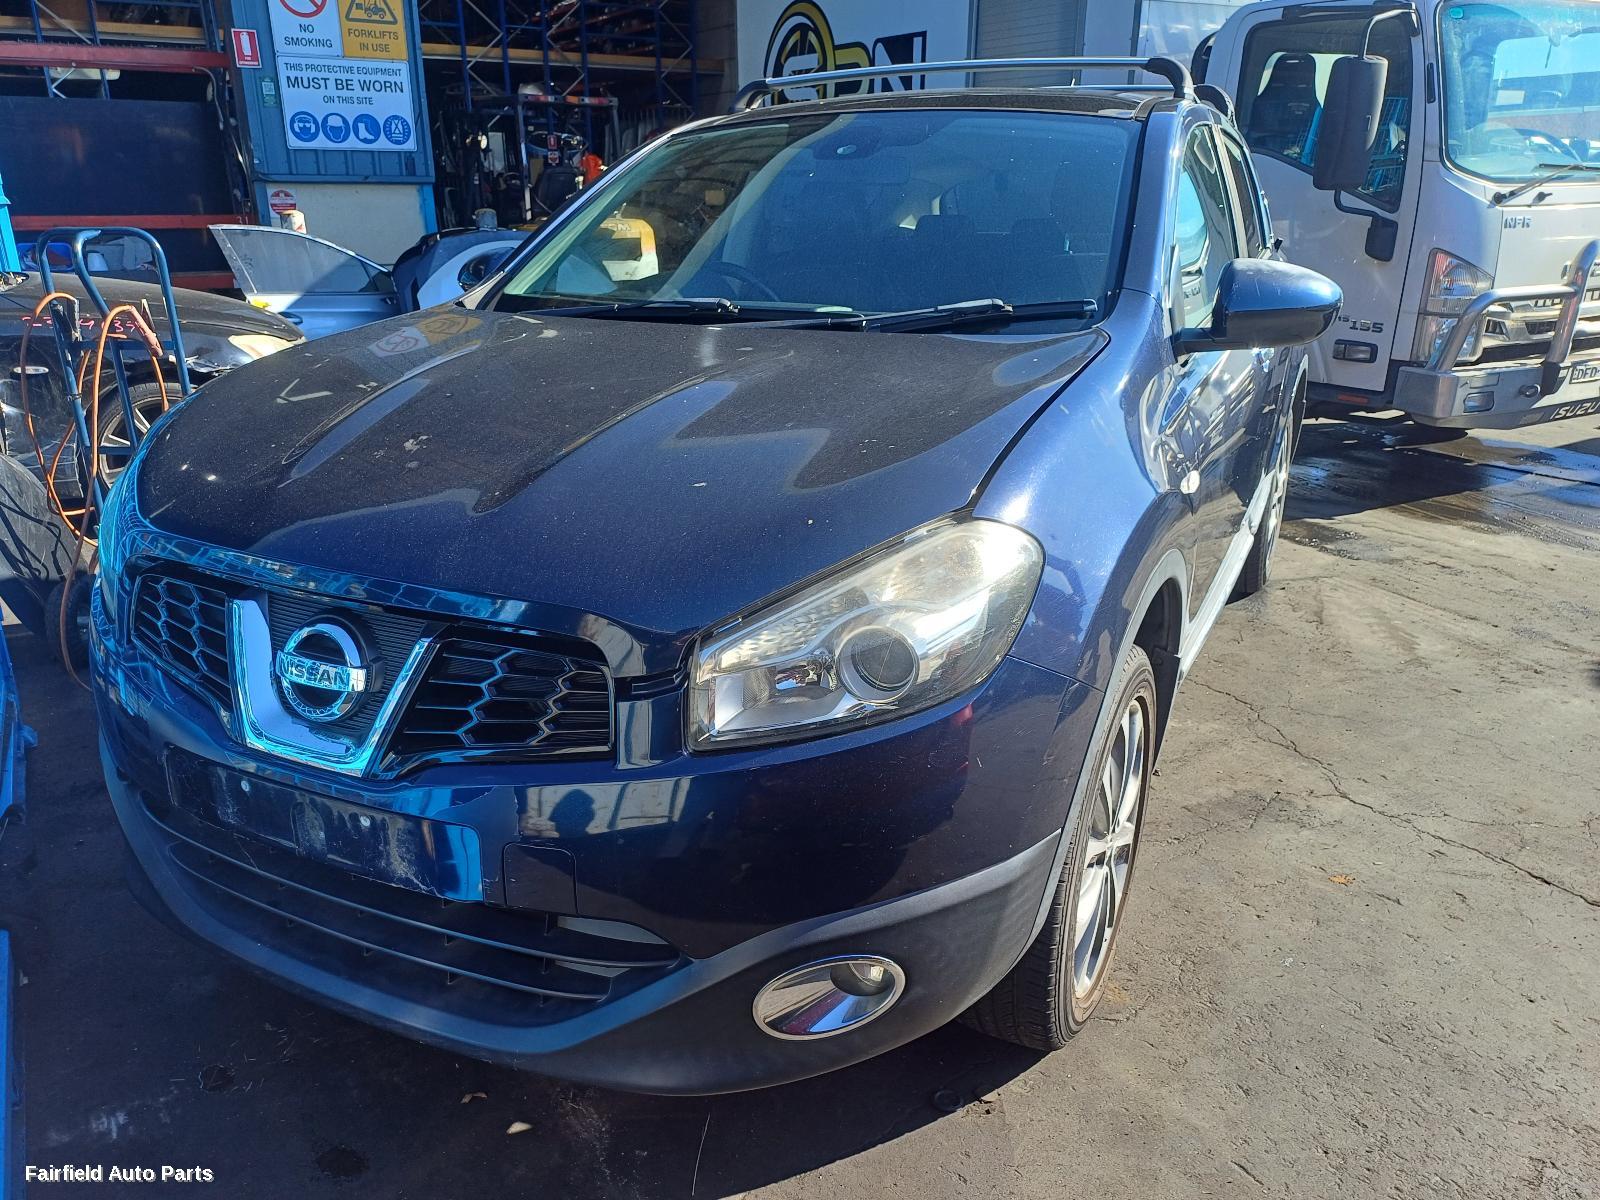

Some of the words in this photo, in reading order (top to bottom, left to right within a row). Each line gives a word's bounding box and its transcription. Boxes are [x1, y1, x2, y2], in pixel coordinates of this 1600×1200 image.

[299, 24, 314, 33] NO
[348, 28, 399, 40] FORKLIFTS
[284, 36, 333, 48] SMOKING
[360, 42, 368, 51] IN
[372, 44, 390, 52] USE
[284, 63, 303, 72] THIS
[305, 64, 355, 75] PROTECTIVE
[357, 66, 401, 77] EQUIPMENT
[286, 76, 329, 90] MUST
[335, 79, 355, 91] BE
[358, 80, 404, 93] WORN
[323, 95, 335, 104] ON
[336, 96, 355, 105] THIS
[357, 97, 374, 105] SITE
[1550, 402, 1600, 420] ISUZU
[282, 657, 351, 688] NISSAN
